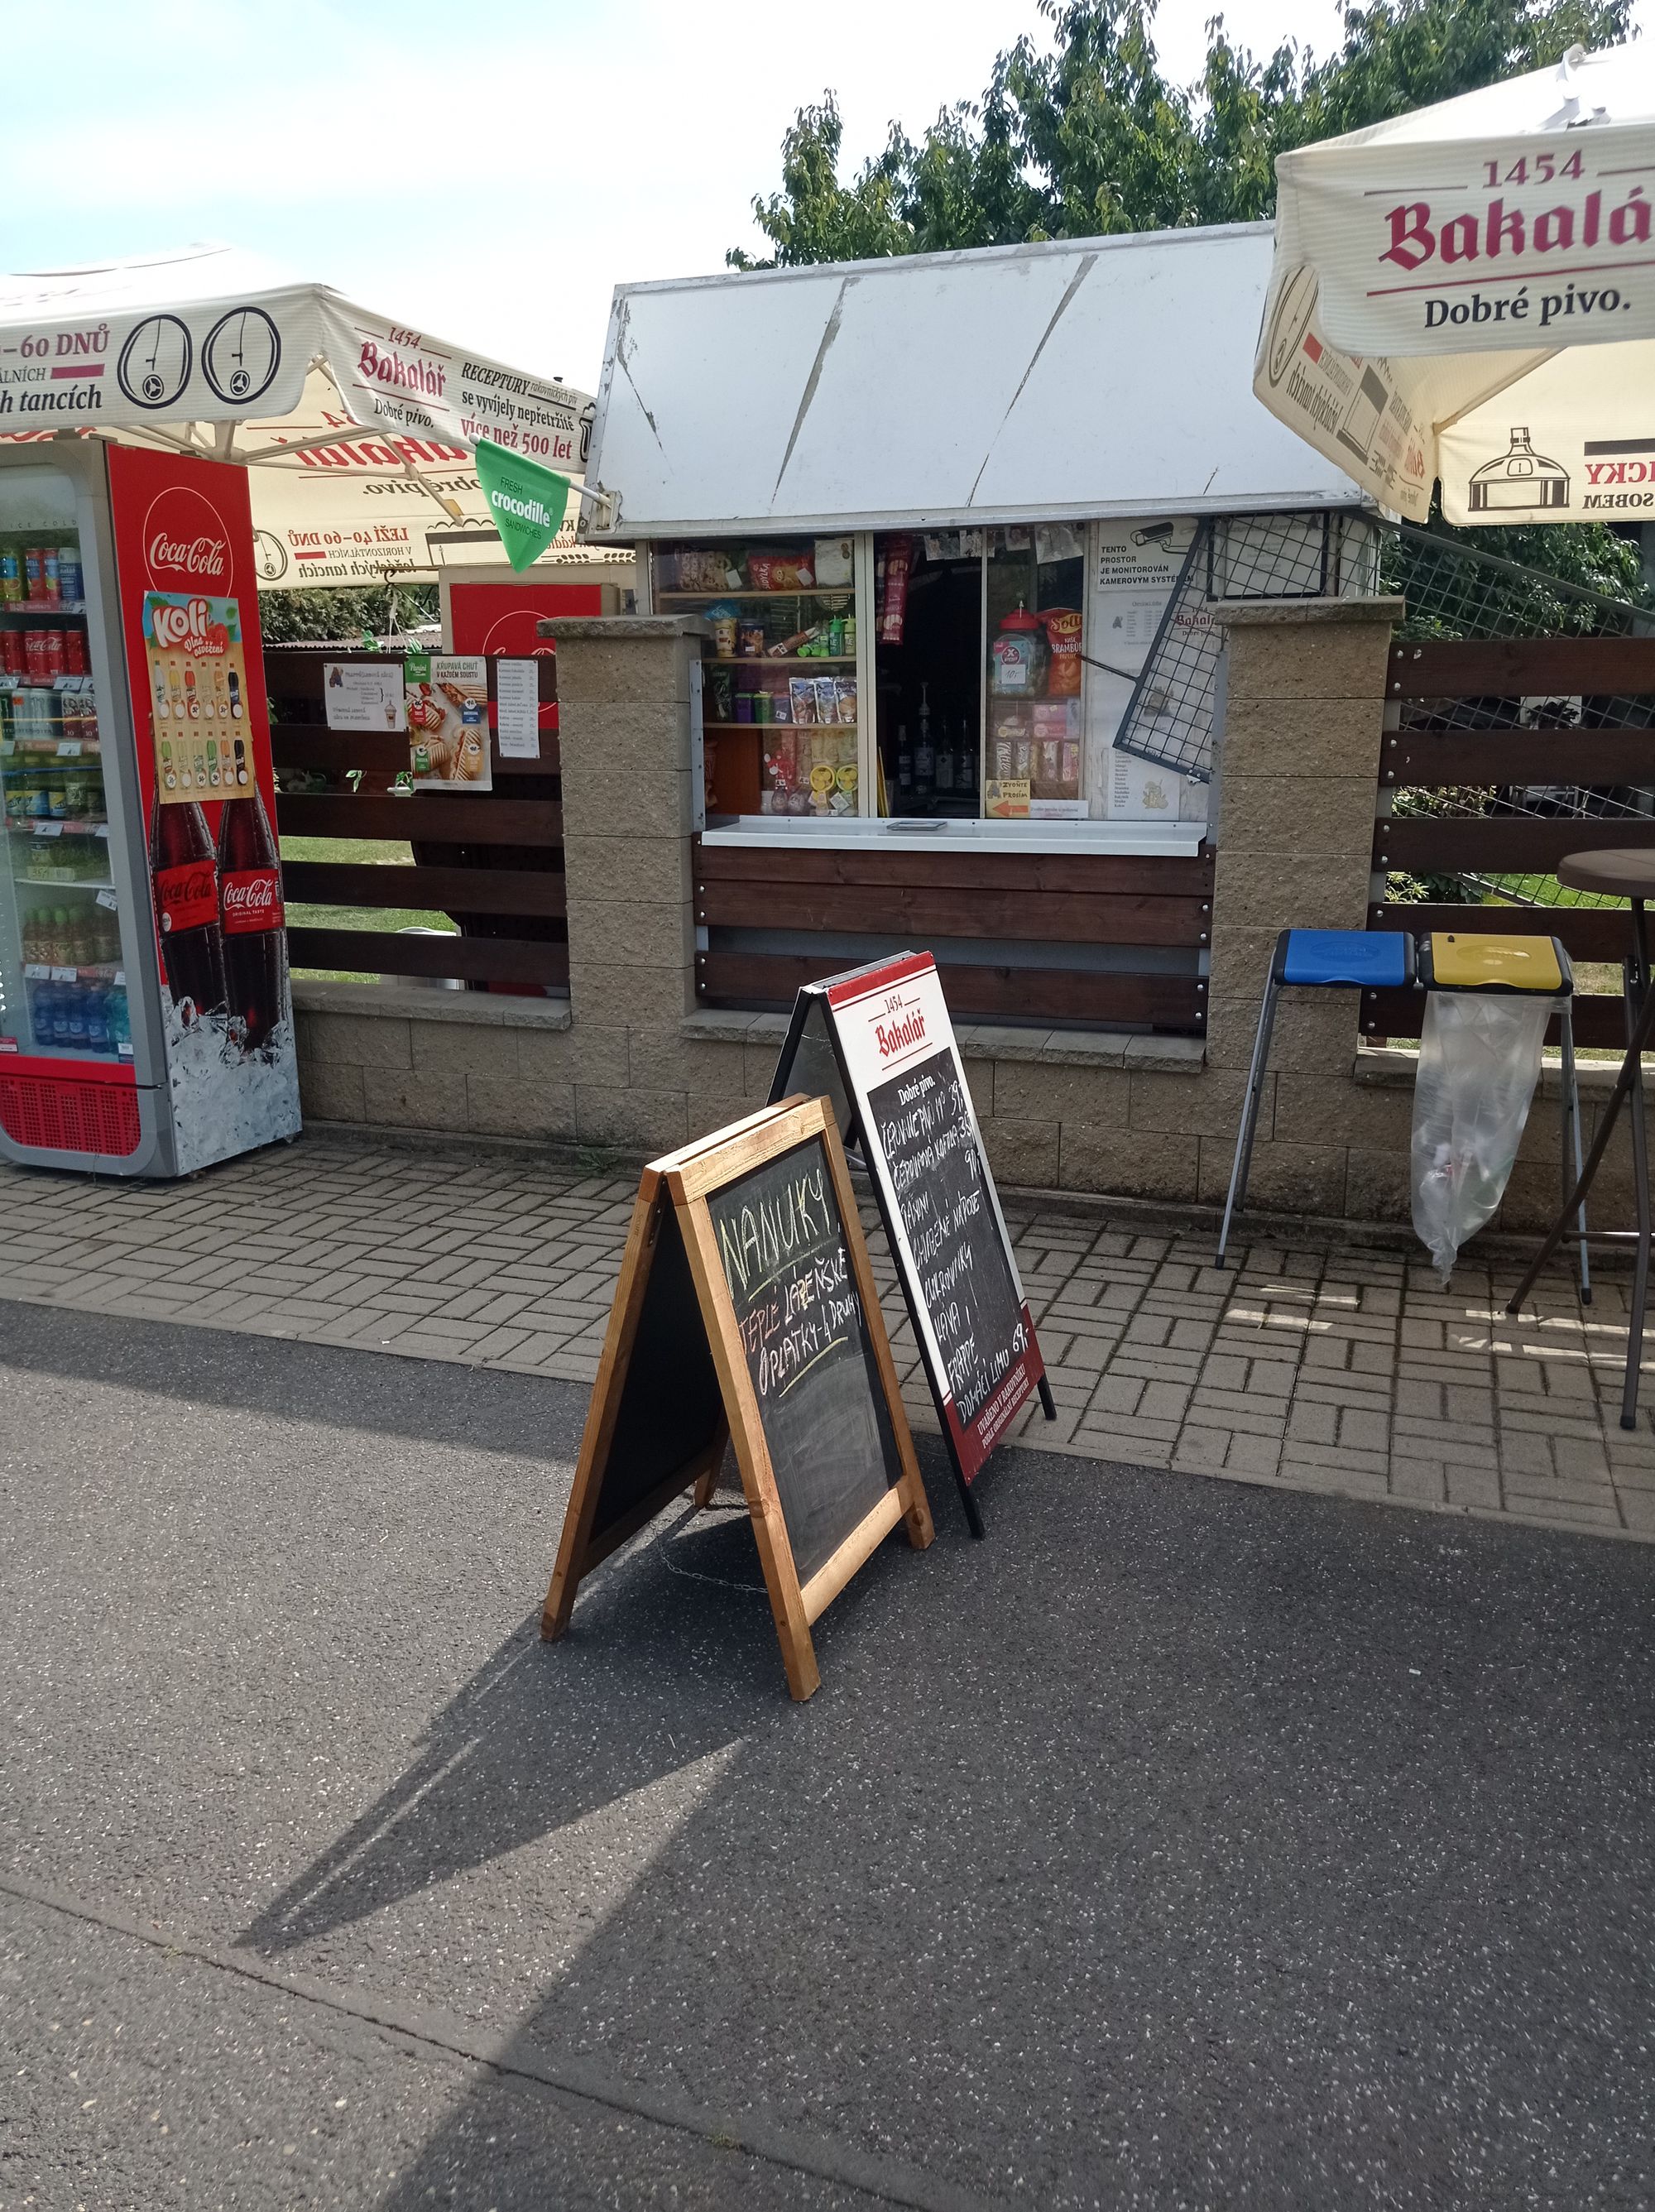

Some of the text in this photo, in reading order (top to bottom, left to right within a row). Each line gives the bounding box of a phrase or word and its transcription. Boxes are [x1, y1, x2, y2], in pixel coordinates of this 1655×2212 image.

[1482, 148, 1586, 189] 1454
[1424, 283, 1631, 329] Dobré pivo.
[55, 323, 110, 355] DNŮ
[388, 326, 422, 349] 1454
[357, 340, 447, 398] Bakalář
[461, 362, 578, 405] RECEPTURY rakovnických piv
[20, 384, 102, 412] tancích
[374, 398, 404, 422] Dobré
[405, 408, 434, 429] pivo.
[462, 391, 575, 431] se vyvíjely nepřetržitě
[461, 411, 573, 459] více než 500 let
[501, 477, 523, 495] FRESH
[491, 490, 551, 528] crocodille
[505, 518, 542, 540] SANDWICHES
[150, 532, 225, 577] Coca-Cola
[1100, 555, 1137, 564] PROSTOR
[1111, 564, 1169, 573] MONITOROVÁN
[1100, 575, 1149, 585] KAMEROVÝM
[437, 661, 478, 670] KŘUPAVÁ CHUŤ
[1002, 790, 1028, 799] PROSÍM
[223, 879, 274, 911] Coca-Cola
[233, 909, 252, 918] ORIGINAL
[884, 993, 904, 1014] 1454
[875, 1008, 926, 1058] Bakalář
[898, 1074, 936, 1106] Dobré pivo.
[718, 1168, 832, 1300] NANUKY
[738, 1225, 849, 1357] TEPLÉ LÁZEŇSKÉ
[828, 1291, 862, 1331] DRUHY
[957, 1358, 991, 1424] DOMÁCÍ
[977, 1363, 1026, 1436] UVAŘENO V RAKOVNÍKU
[981, 1377, 1029, 1450] PODLE ORIGINÁLNÍ RECEPTURY
